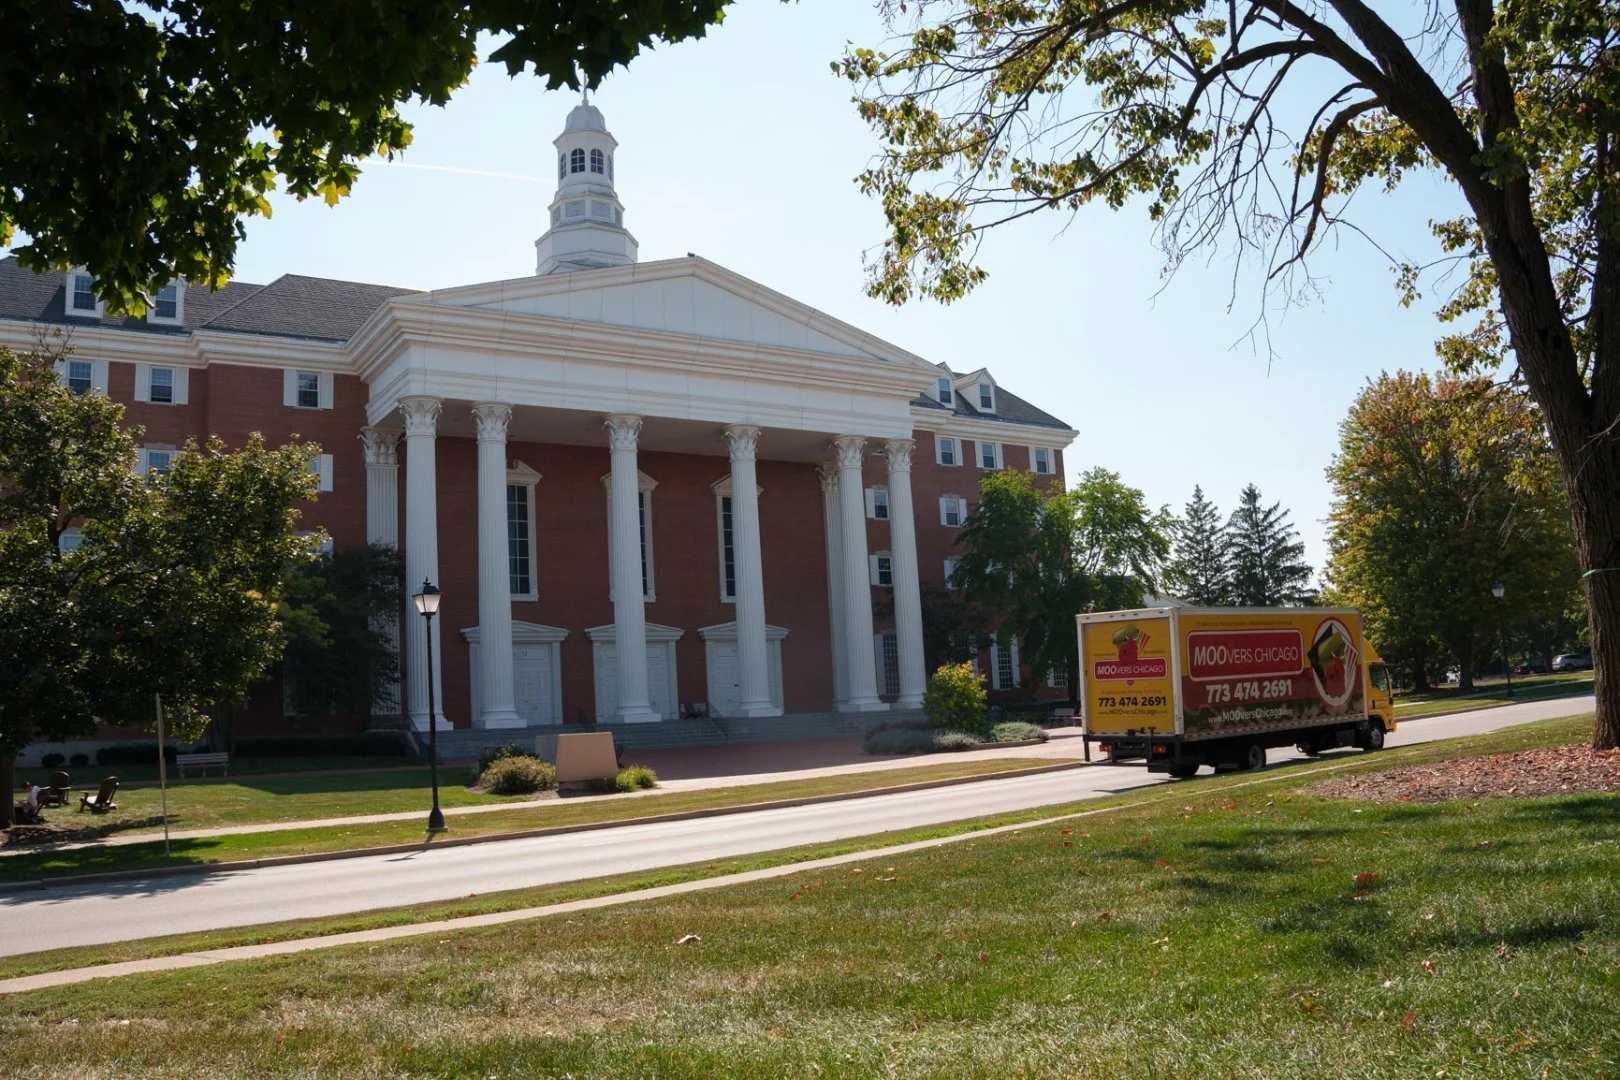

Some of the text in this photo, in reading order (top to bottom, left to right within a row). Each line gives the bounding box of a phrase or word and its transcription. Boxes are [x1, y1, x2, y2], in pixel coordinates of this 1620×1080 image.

[1194, 646, 1299, 666] MOOVERS CHICAGO
[1097, 664, 1164, 675] MOOVERS CHICAGO
[1206, 680, 1293, 703] 773 474 2691
[1098, 696, 1167, 707] 773 474 2691
